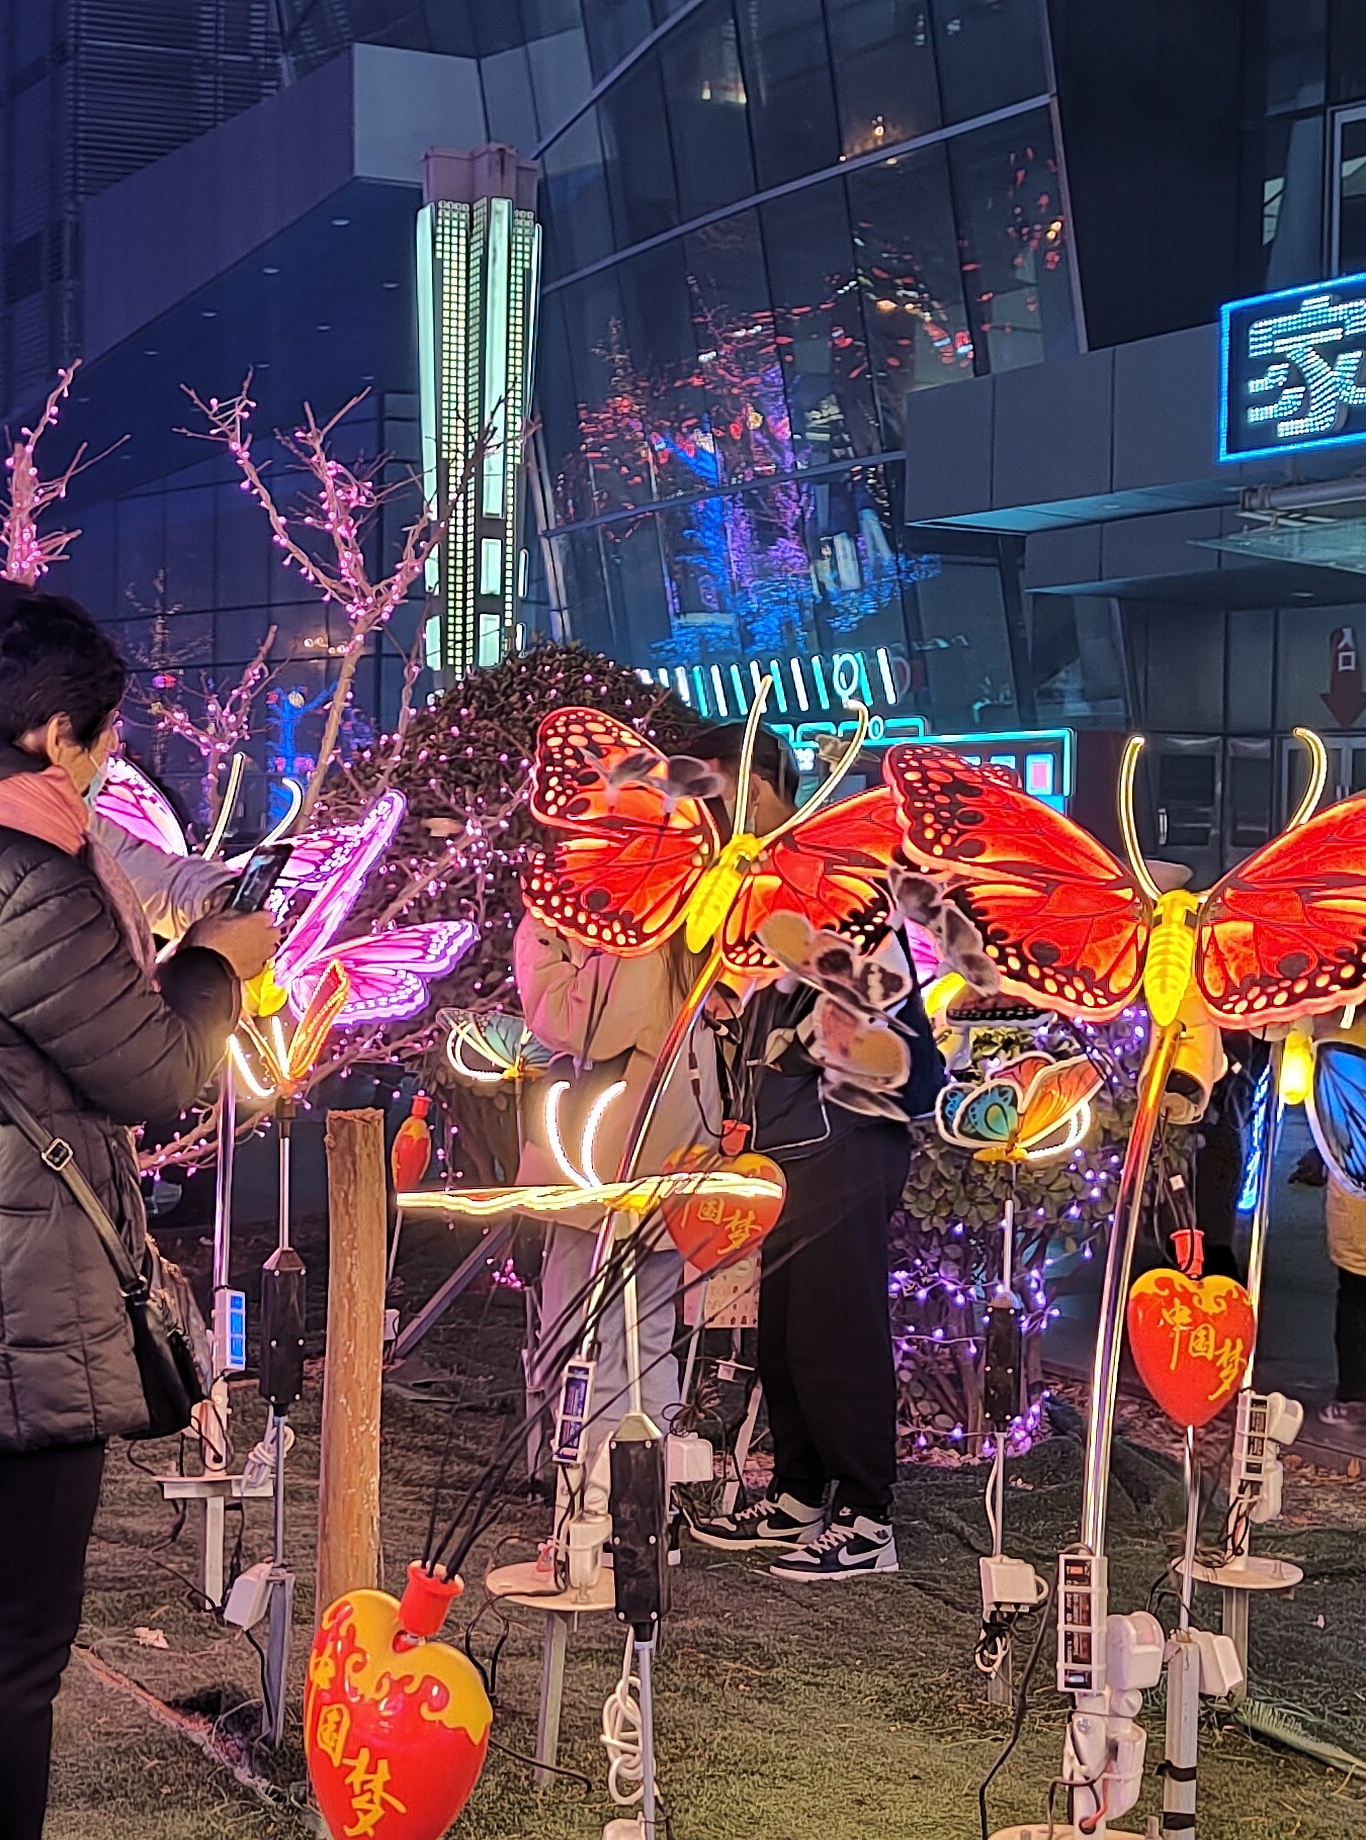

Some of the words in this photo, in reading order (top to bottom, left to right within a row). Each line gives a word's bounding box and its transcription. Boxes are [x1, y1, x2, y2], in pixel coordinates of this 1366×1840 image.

[1337, 627, 1357, 672] 入口
[1161, 1297, 1248, 1401] 中国梦
[305, 1642, 407, 1837] 中国梦
